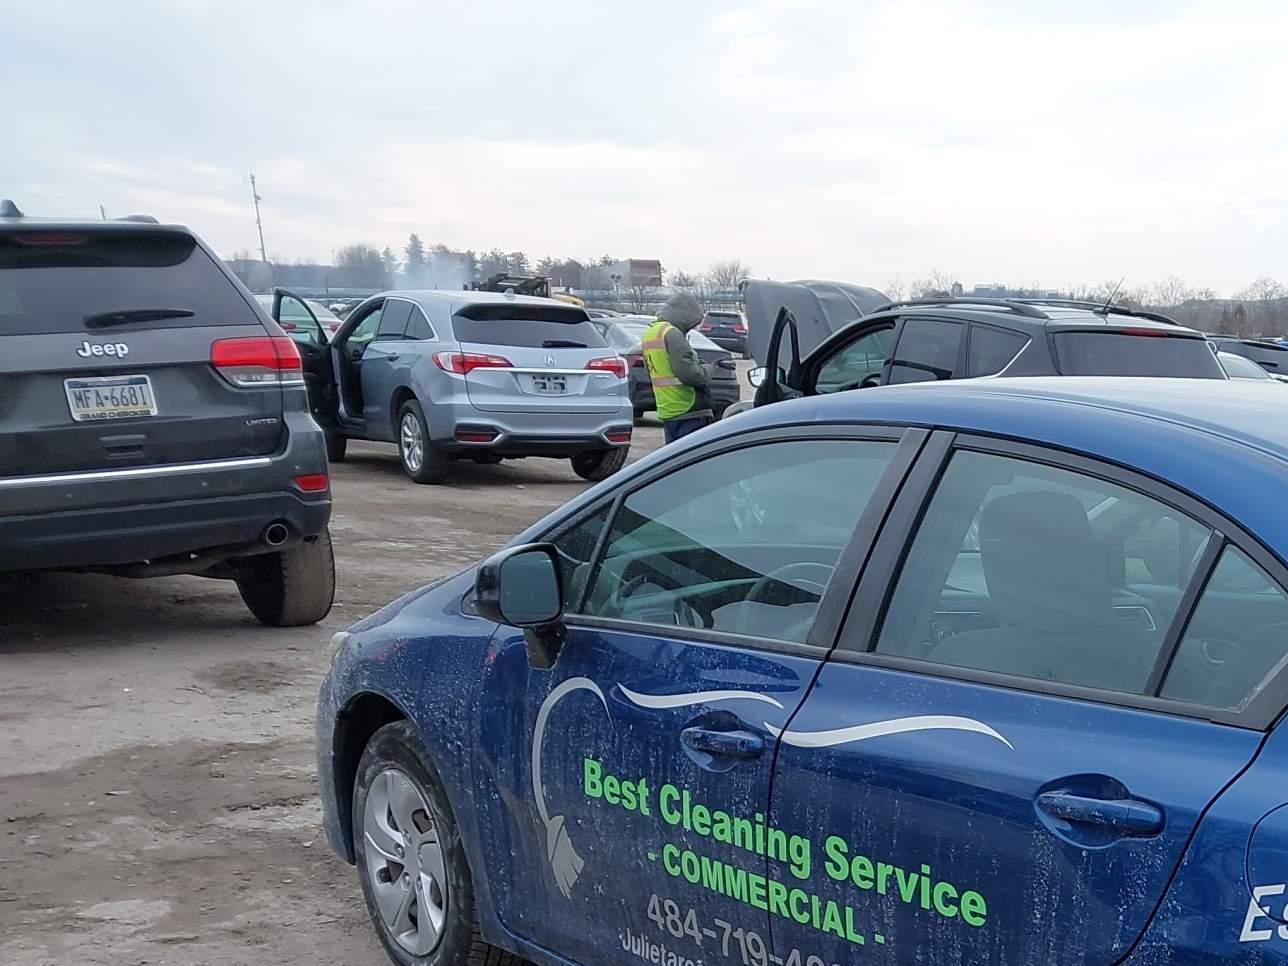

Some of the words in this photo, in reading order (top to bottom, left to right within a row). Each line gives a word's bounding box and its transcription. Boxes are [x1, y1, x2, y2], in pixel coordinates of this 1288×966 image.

[77, 341, 129, 358] Jeep
[584, 758, 650, 817] Best
[659, 783, 811, 880] Cleaning
[824, 835, 988, 927] Service
[662, 843, 865, 946] COMMERCIAL
